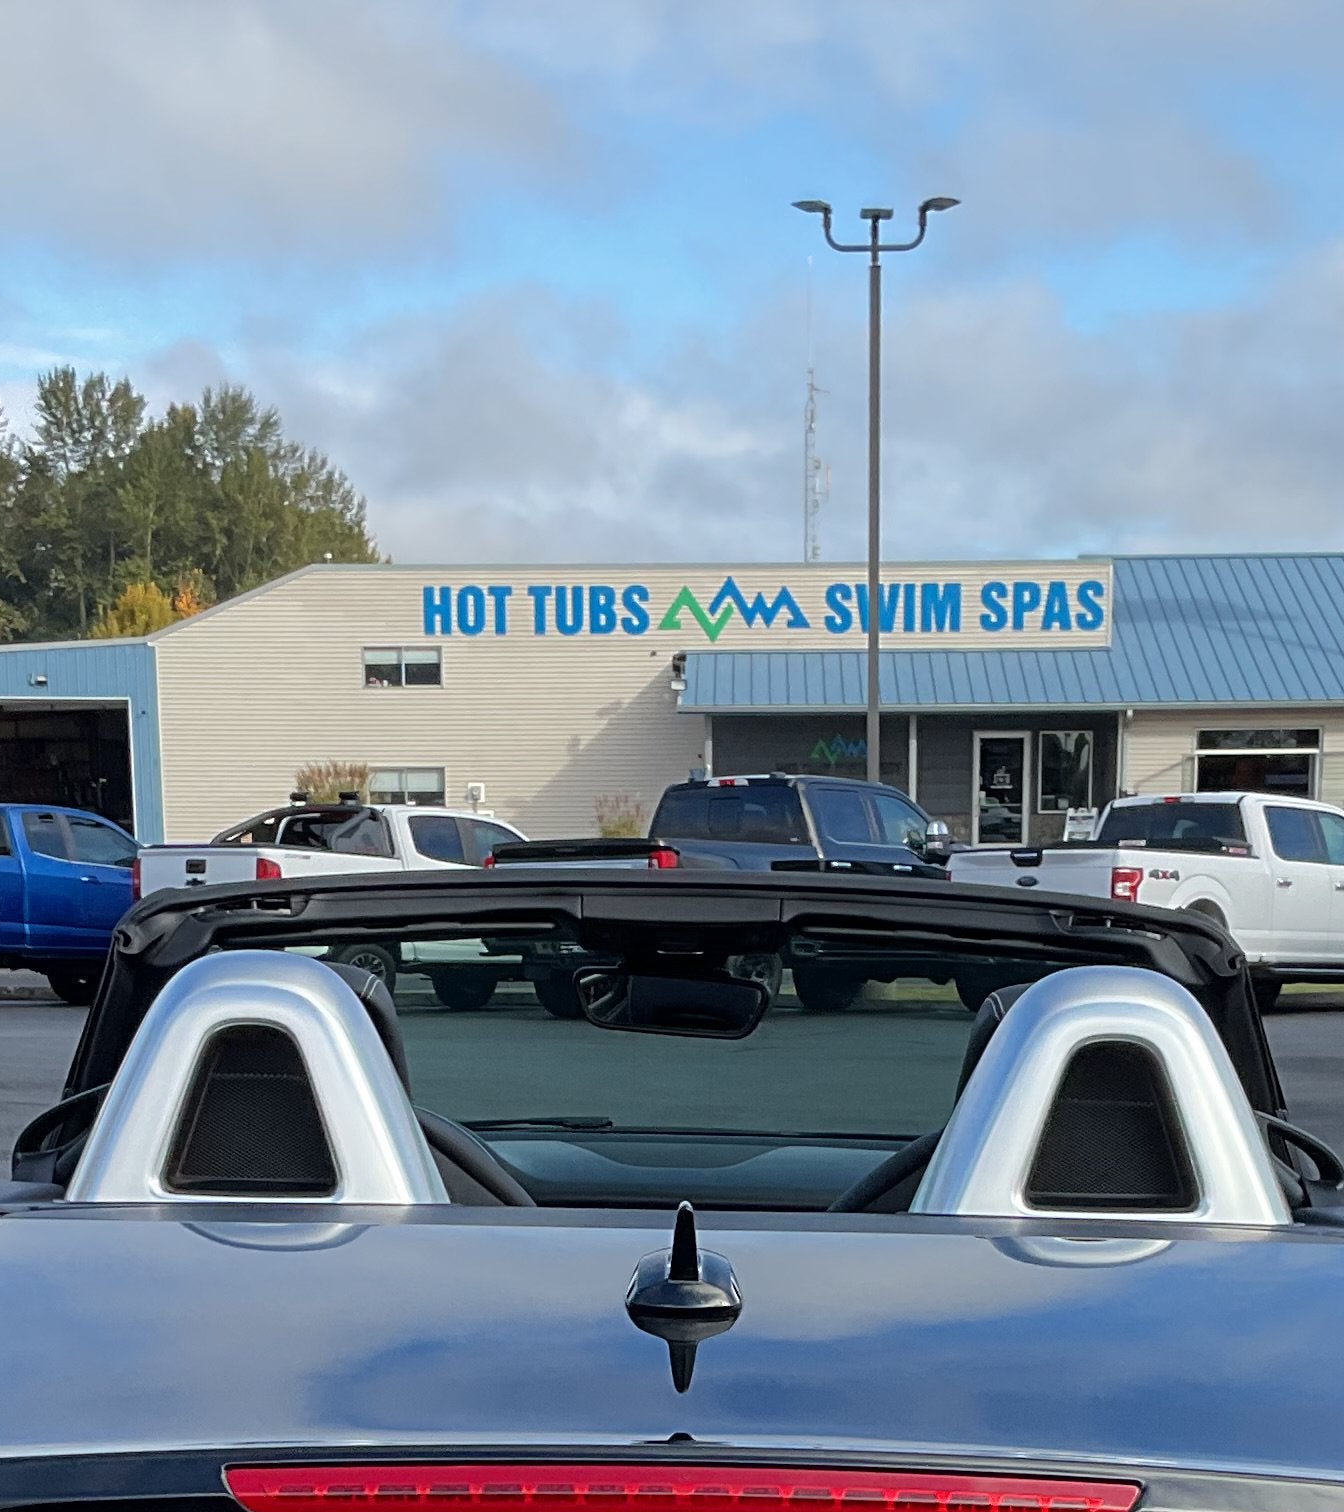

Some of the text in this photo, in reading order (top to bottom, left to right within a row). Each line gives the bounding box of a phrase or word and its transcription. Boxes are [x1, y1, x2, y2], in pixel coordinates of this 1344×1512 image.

[422, 580, 1105, 635] HOT TUBS SWIM SPAS
